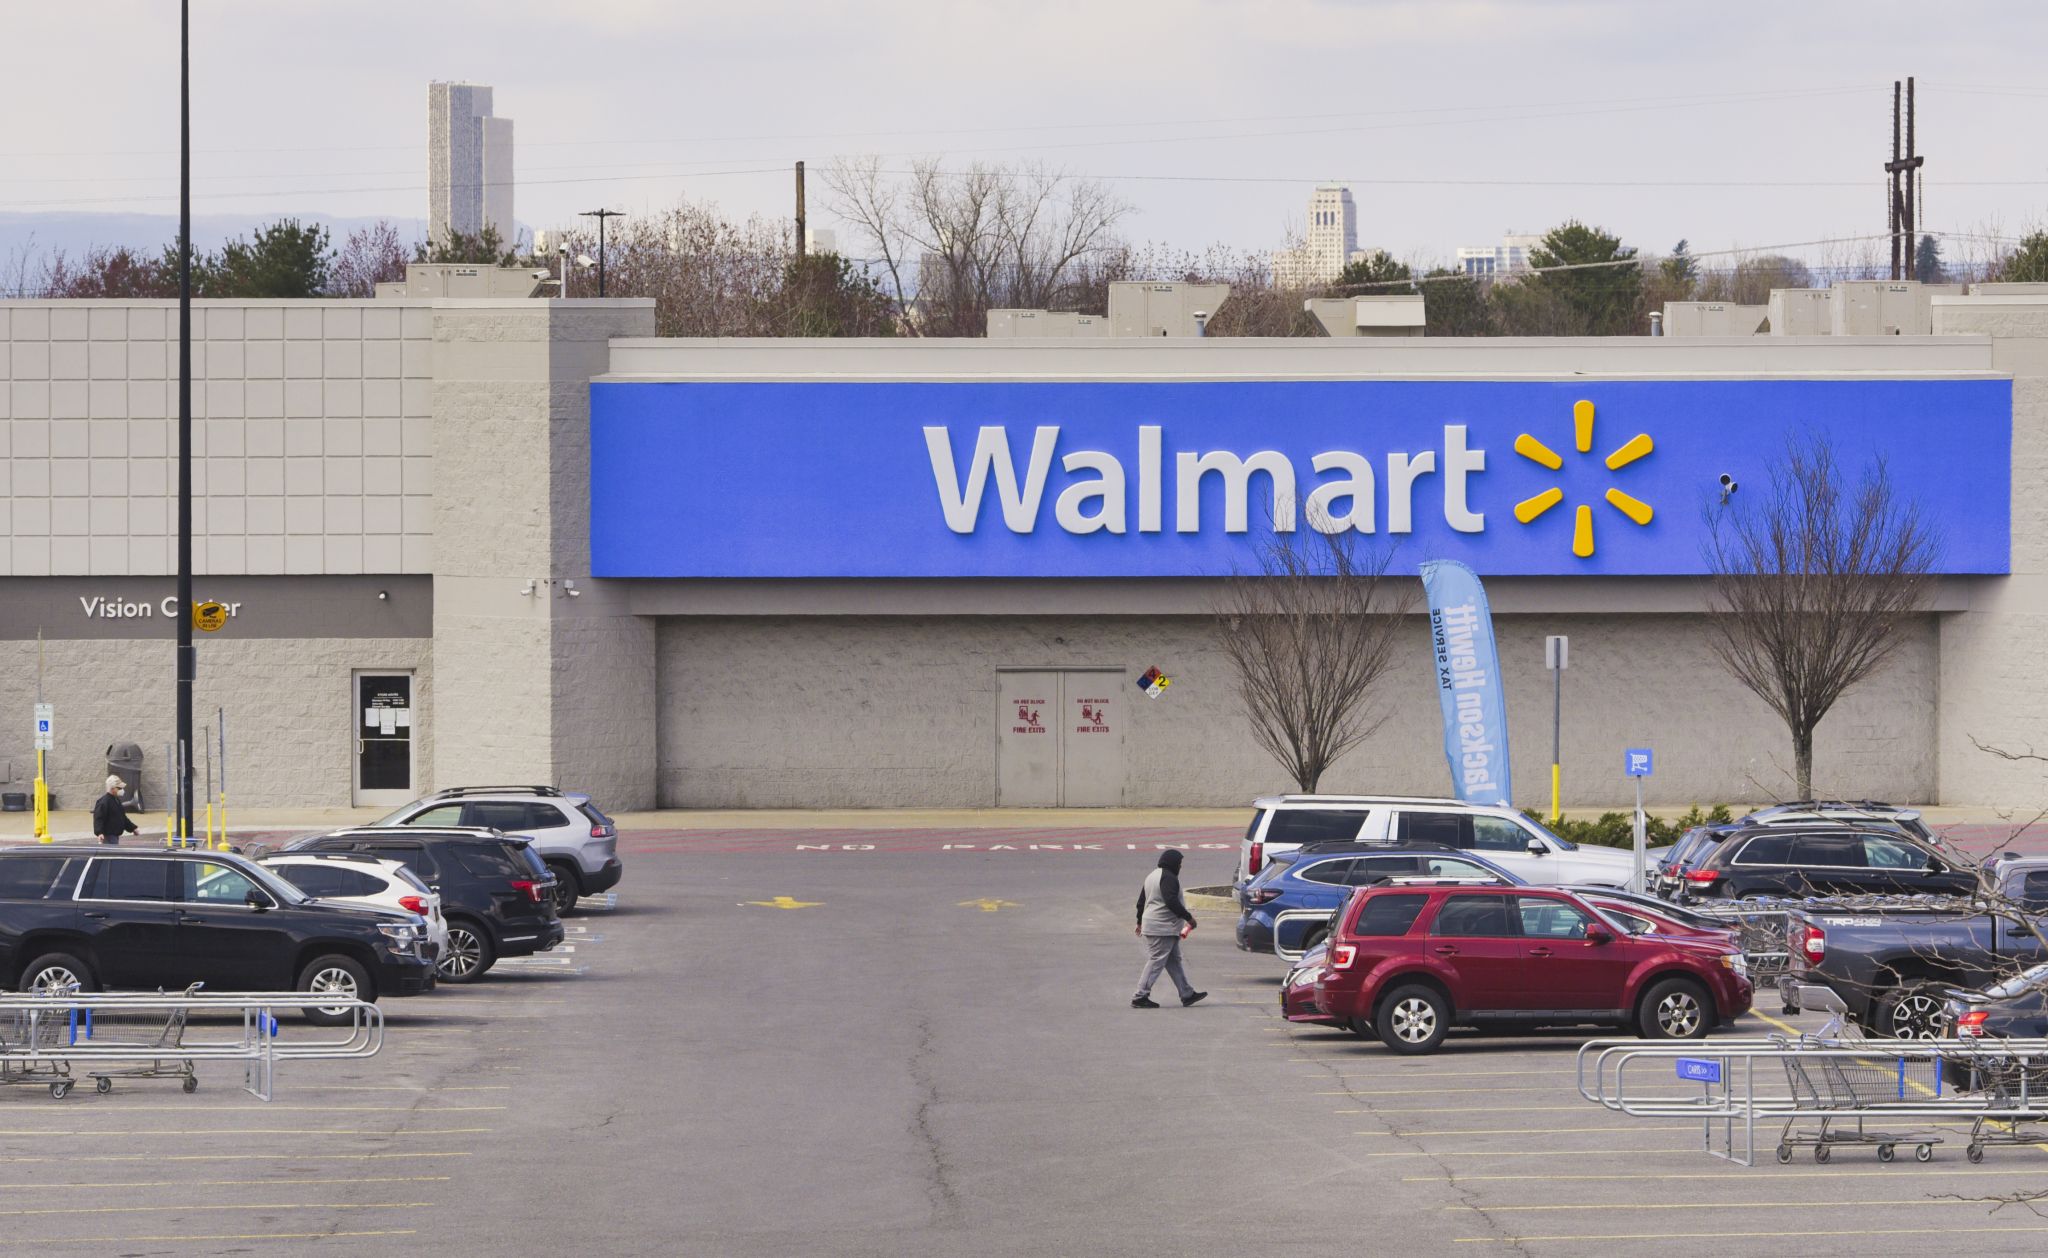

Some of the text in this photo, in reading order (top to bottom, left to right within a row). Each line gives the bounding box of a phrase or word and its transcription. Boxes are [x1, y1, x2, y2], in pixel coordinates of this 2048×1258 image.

[922, 424, 1486, 534] Walmart
[79, 596, 152, 618] Vision
[1158, 675, 1166, 687] 2
